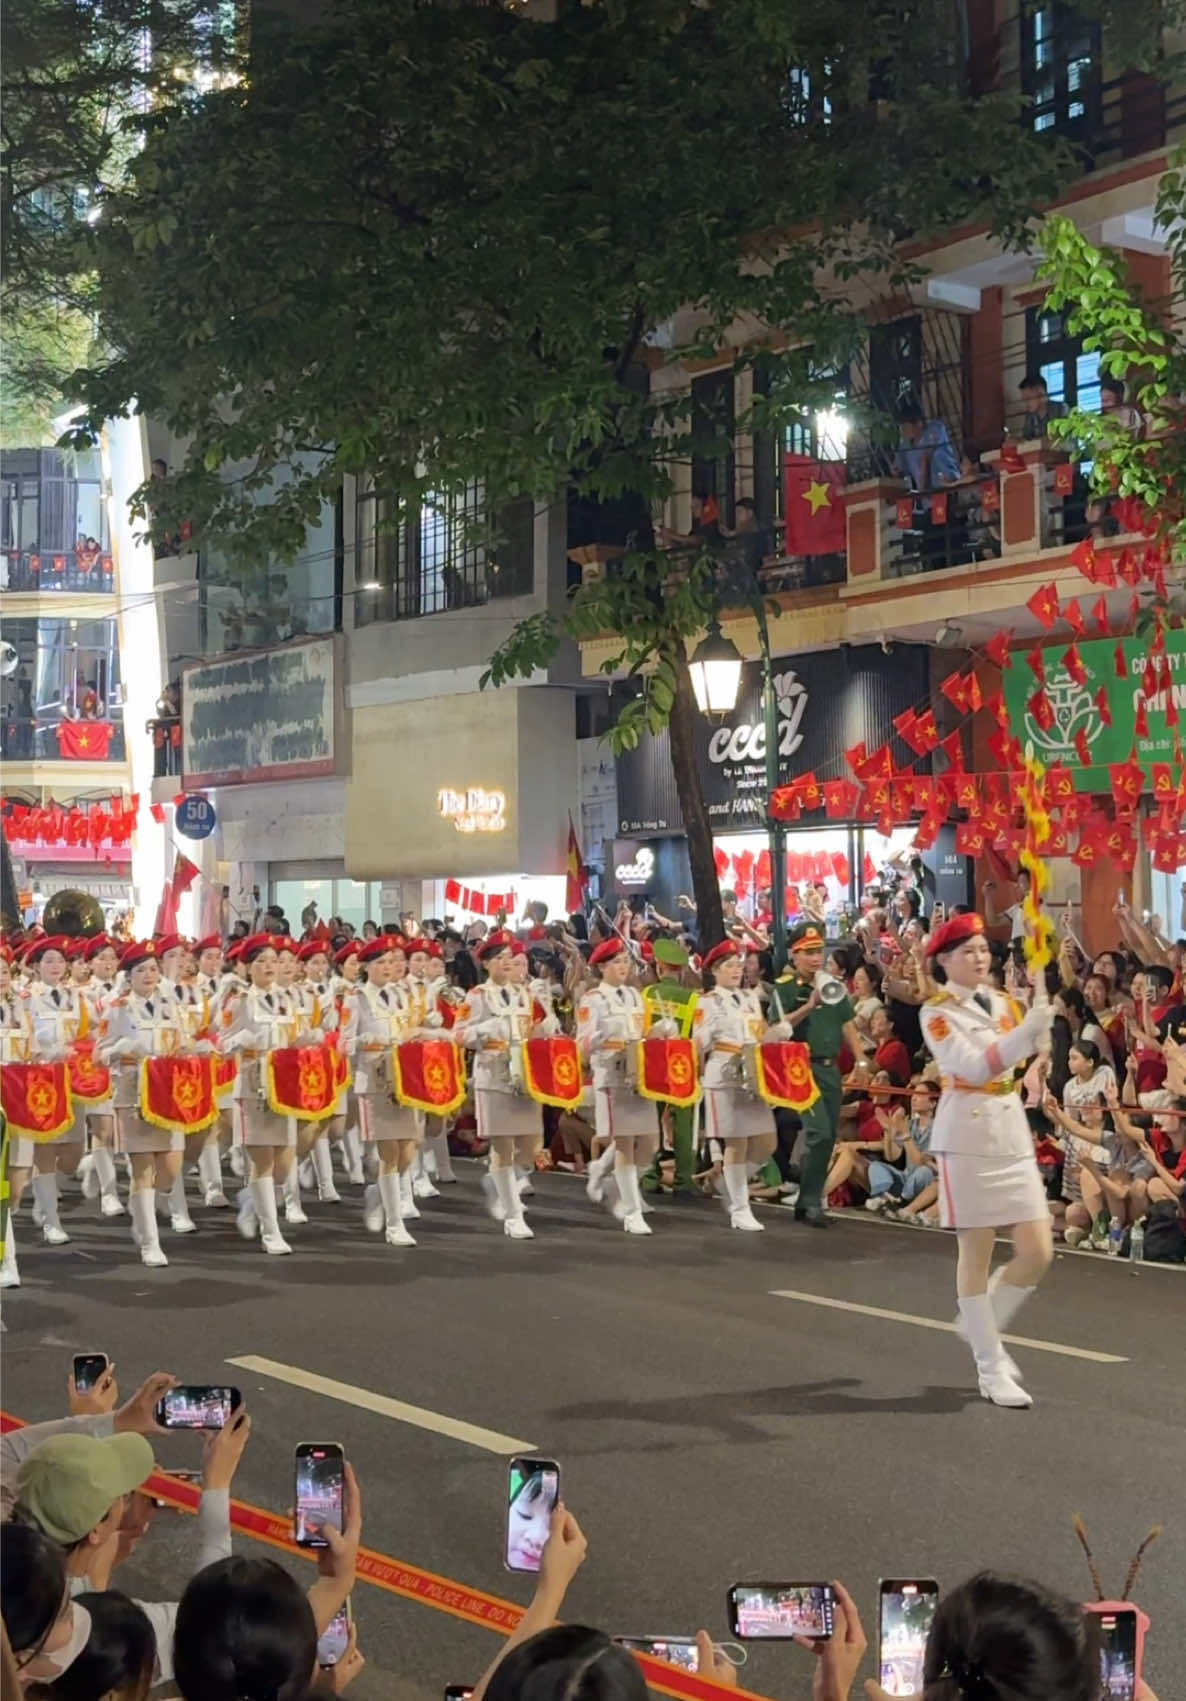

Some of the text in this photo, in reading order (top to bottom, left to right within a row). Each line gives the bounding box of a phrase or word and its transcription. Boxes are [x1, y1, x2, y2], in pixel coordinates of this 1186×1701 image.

[187, 801, 207, 820] 50
[424, 1582, 462, 1606] POLICE
[460, 1596, 486, 1614] LINE
